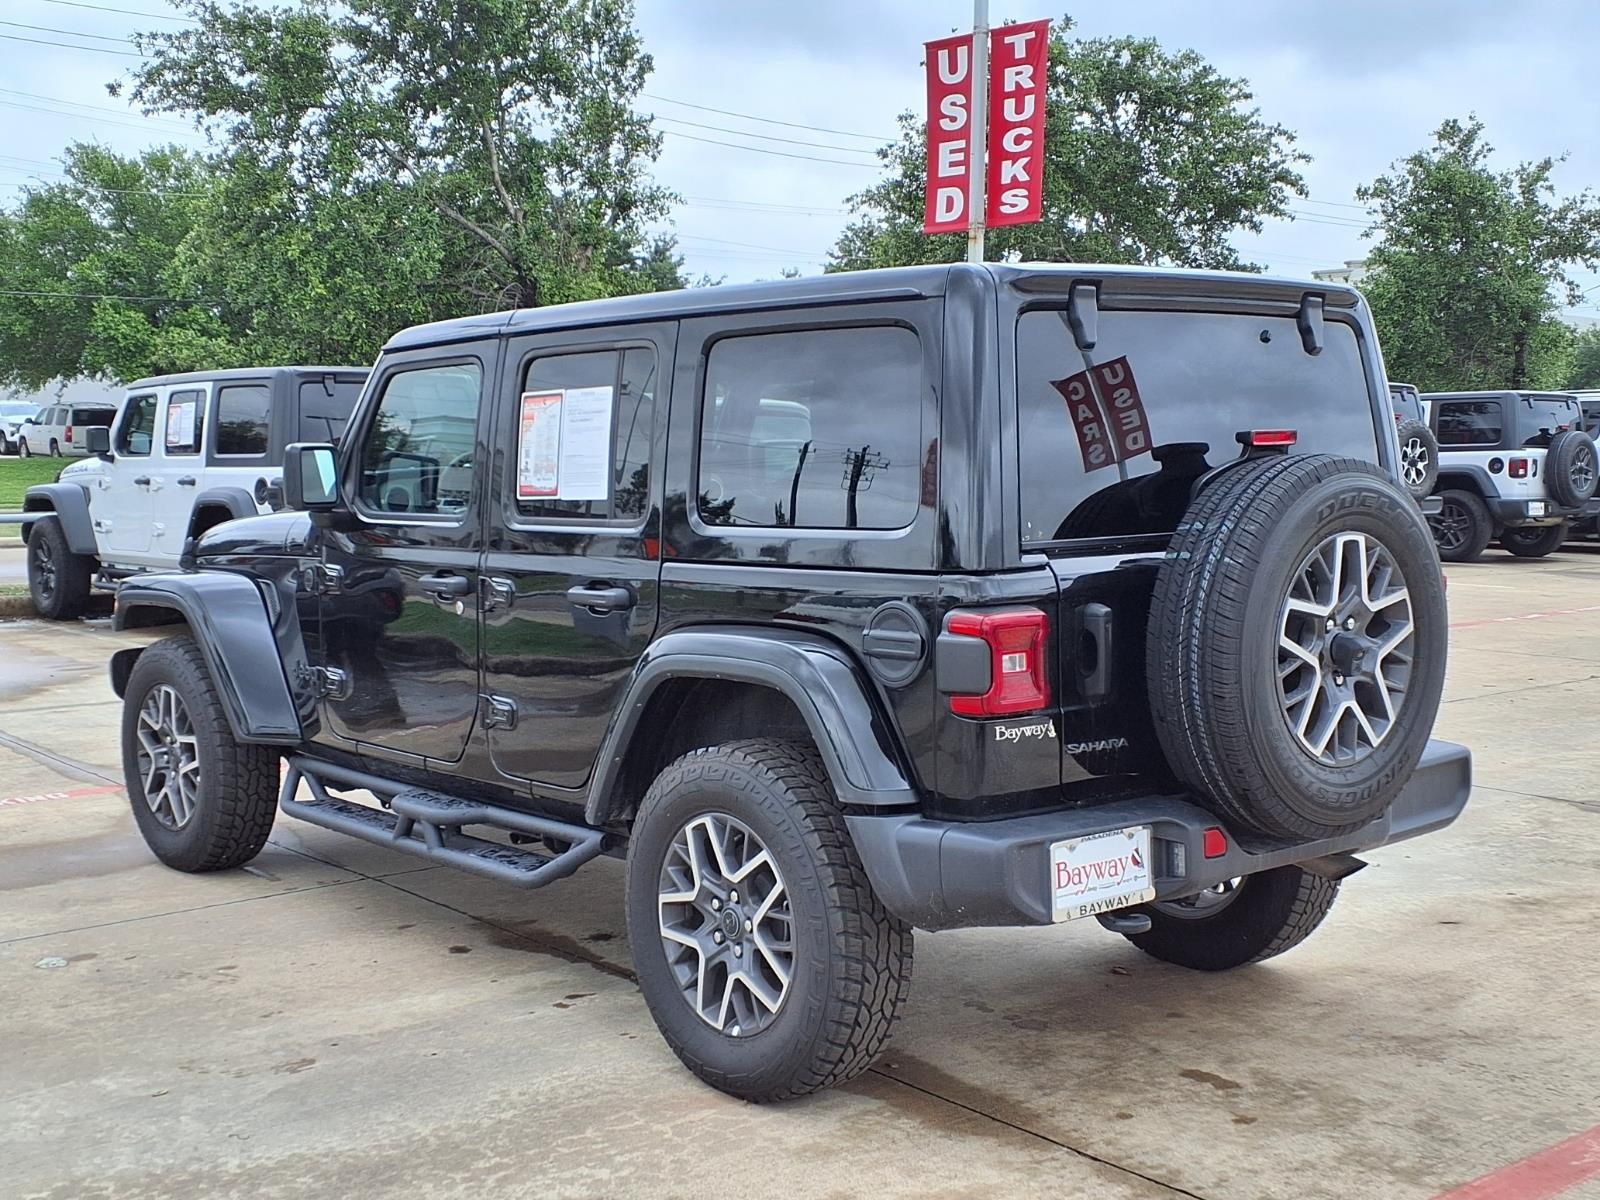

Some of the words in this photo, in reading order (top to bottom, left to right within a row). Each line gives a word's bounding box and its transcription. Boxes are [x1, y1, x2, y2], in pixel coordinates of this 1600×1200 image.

[935, 45, 968, 223] USED
[999, 31, 1036, 214] TRUCKS
[994, 724, 1048, 743] Bayway
[1066, 738, 1128, 754] SAHARA
[1055, 856, 1128, 894] Bayway
[1079, 894, 1131, 916] BAYWAY
